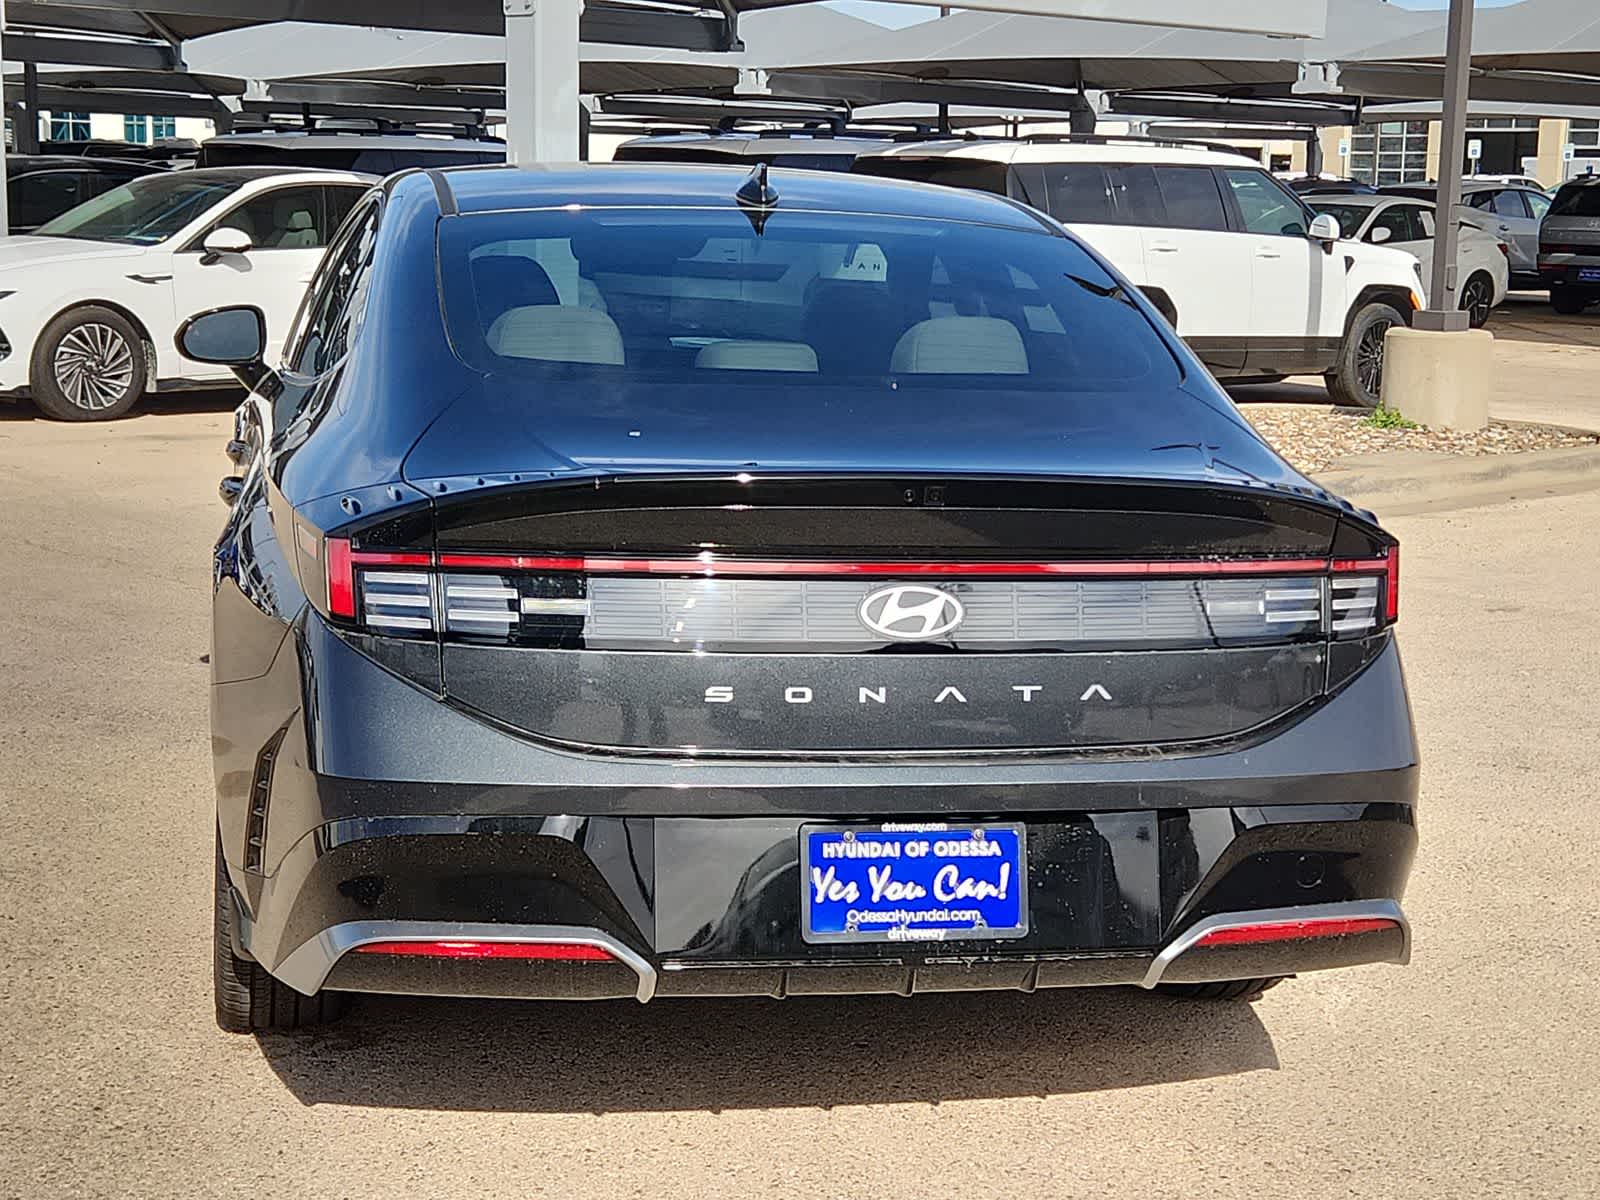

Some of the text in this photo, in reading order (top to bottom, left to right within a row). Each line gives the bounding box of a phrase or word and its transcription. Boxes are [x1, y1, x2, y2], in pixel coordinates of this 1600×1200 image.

[704, 684, 1113, 704] SONATA
[881, 822, 947, 833] driveway.com
[822, 840, 1003, 859] HYUNDAI OF ODESSA
[812, 862, 1011, 903] Yes You Can!
[846, 909, 981, 926] OdessaHyundai.com
[887, 925, 947, 941] driveway
